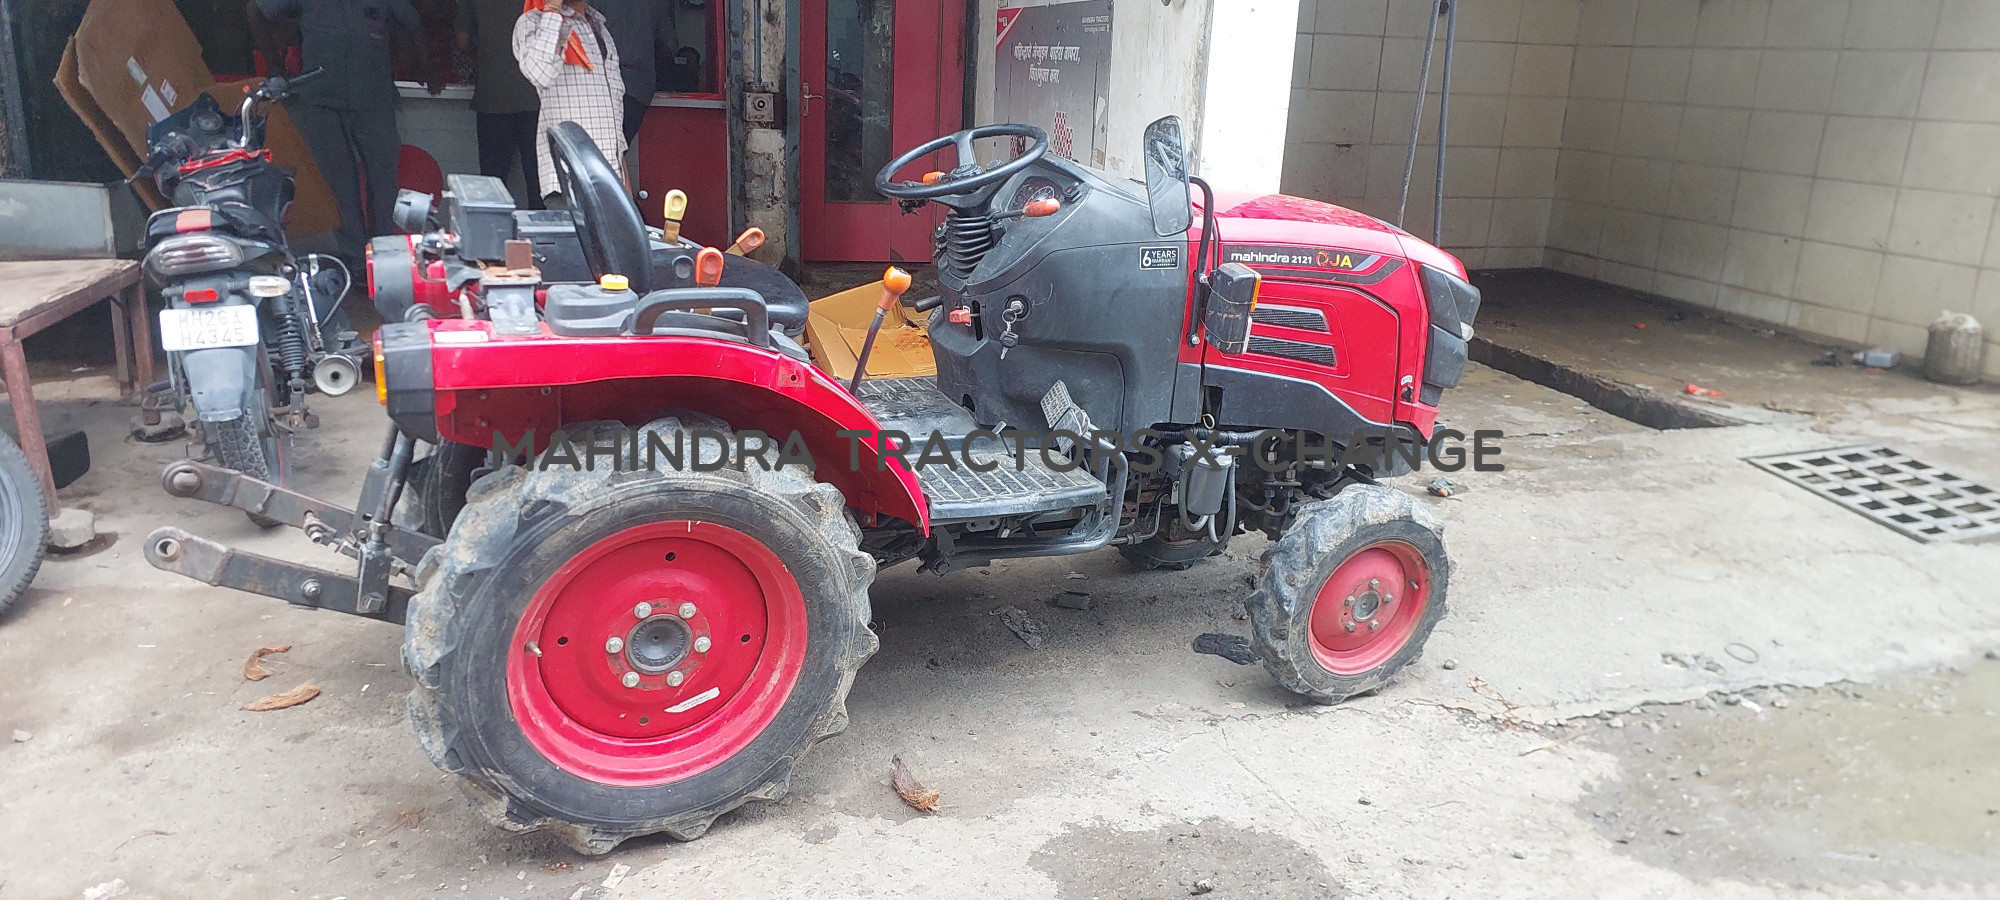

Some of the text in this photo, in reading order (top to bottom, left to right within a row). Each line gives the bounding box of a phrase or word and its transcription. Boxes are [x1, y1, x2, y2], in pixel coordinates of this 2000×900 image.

[1142, 250, 1177, 267] 6 YEARS
[1230, 251, 1290, 263] mahindra
[1291, 255, 1313, 265] 2121
[181, 327, 245, 346] H4345
